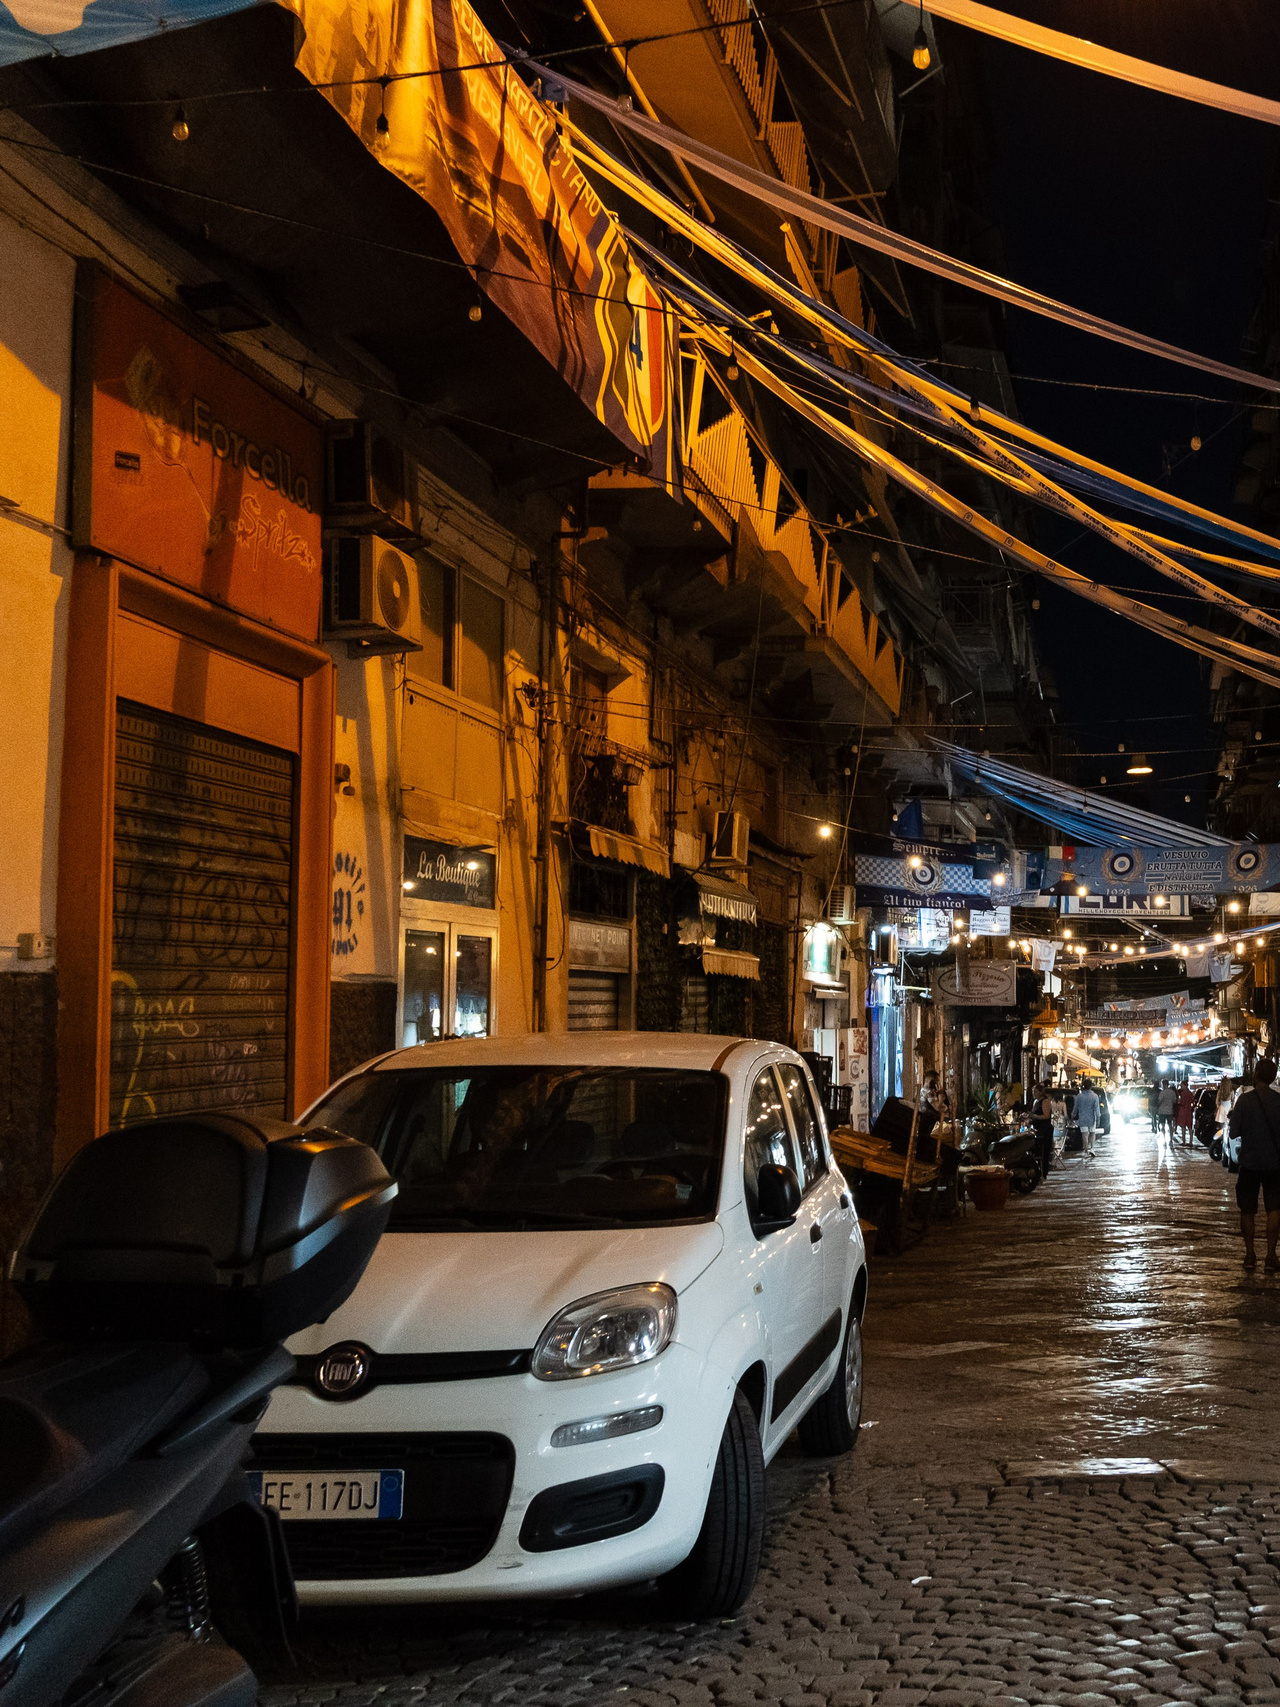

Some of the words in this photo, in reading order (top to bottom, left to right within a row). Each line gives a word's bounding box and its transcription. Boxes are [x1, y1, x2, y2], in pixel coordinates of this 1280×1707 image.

[193, 396, 313, 513] Forcella
[241, 494, 303, 570] Spritz
[1163, 850, 1209, 860] VESUVIO
[417, 851, 433, 880] La
[436, 854, 481, 894] Boutique
[1147, 861, 1187, 871] ERUTTA
[1188, 861, 1222, 870] TUTTA
[1163, 872, 1202, 881] NAPOLI
[1157, 883, 1215, 893] DISTRUTTA
[328, 1362, 356, 1381] FIAT
[306, 1481, 379, 1511] 117DJ
